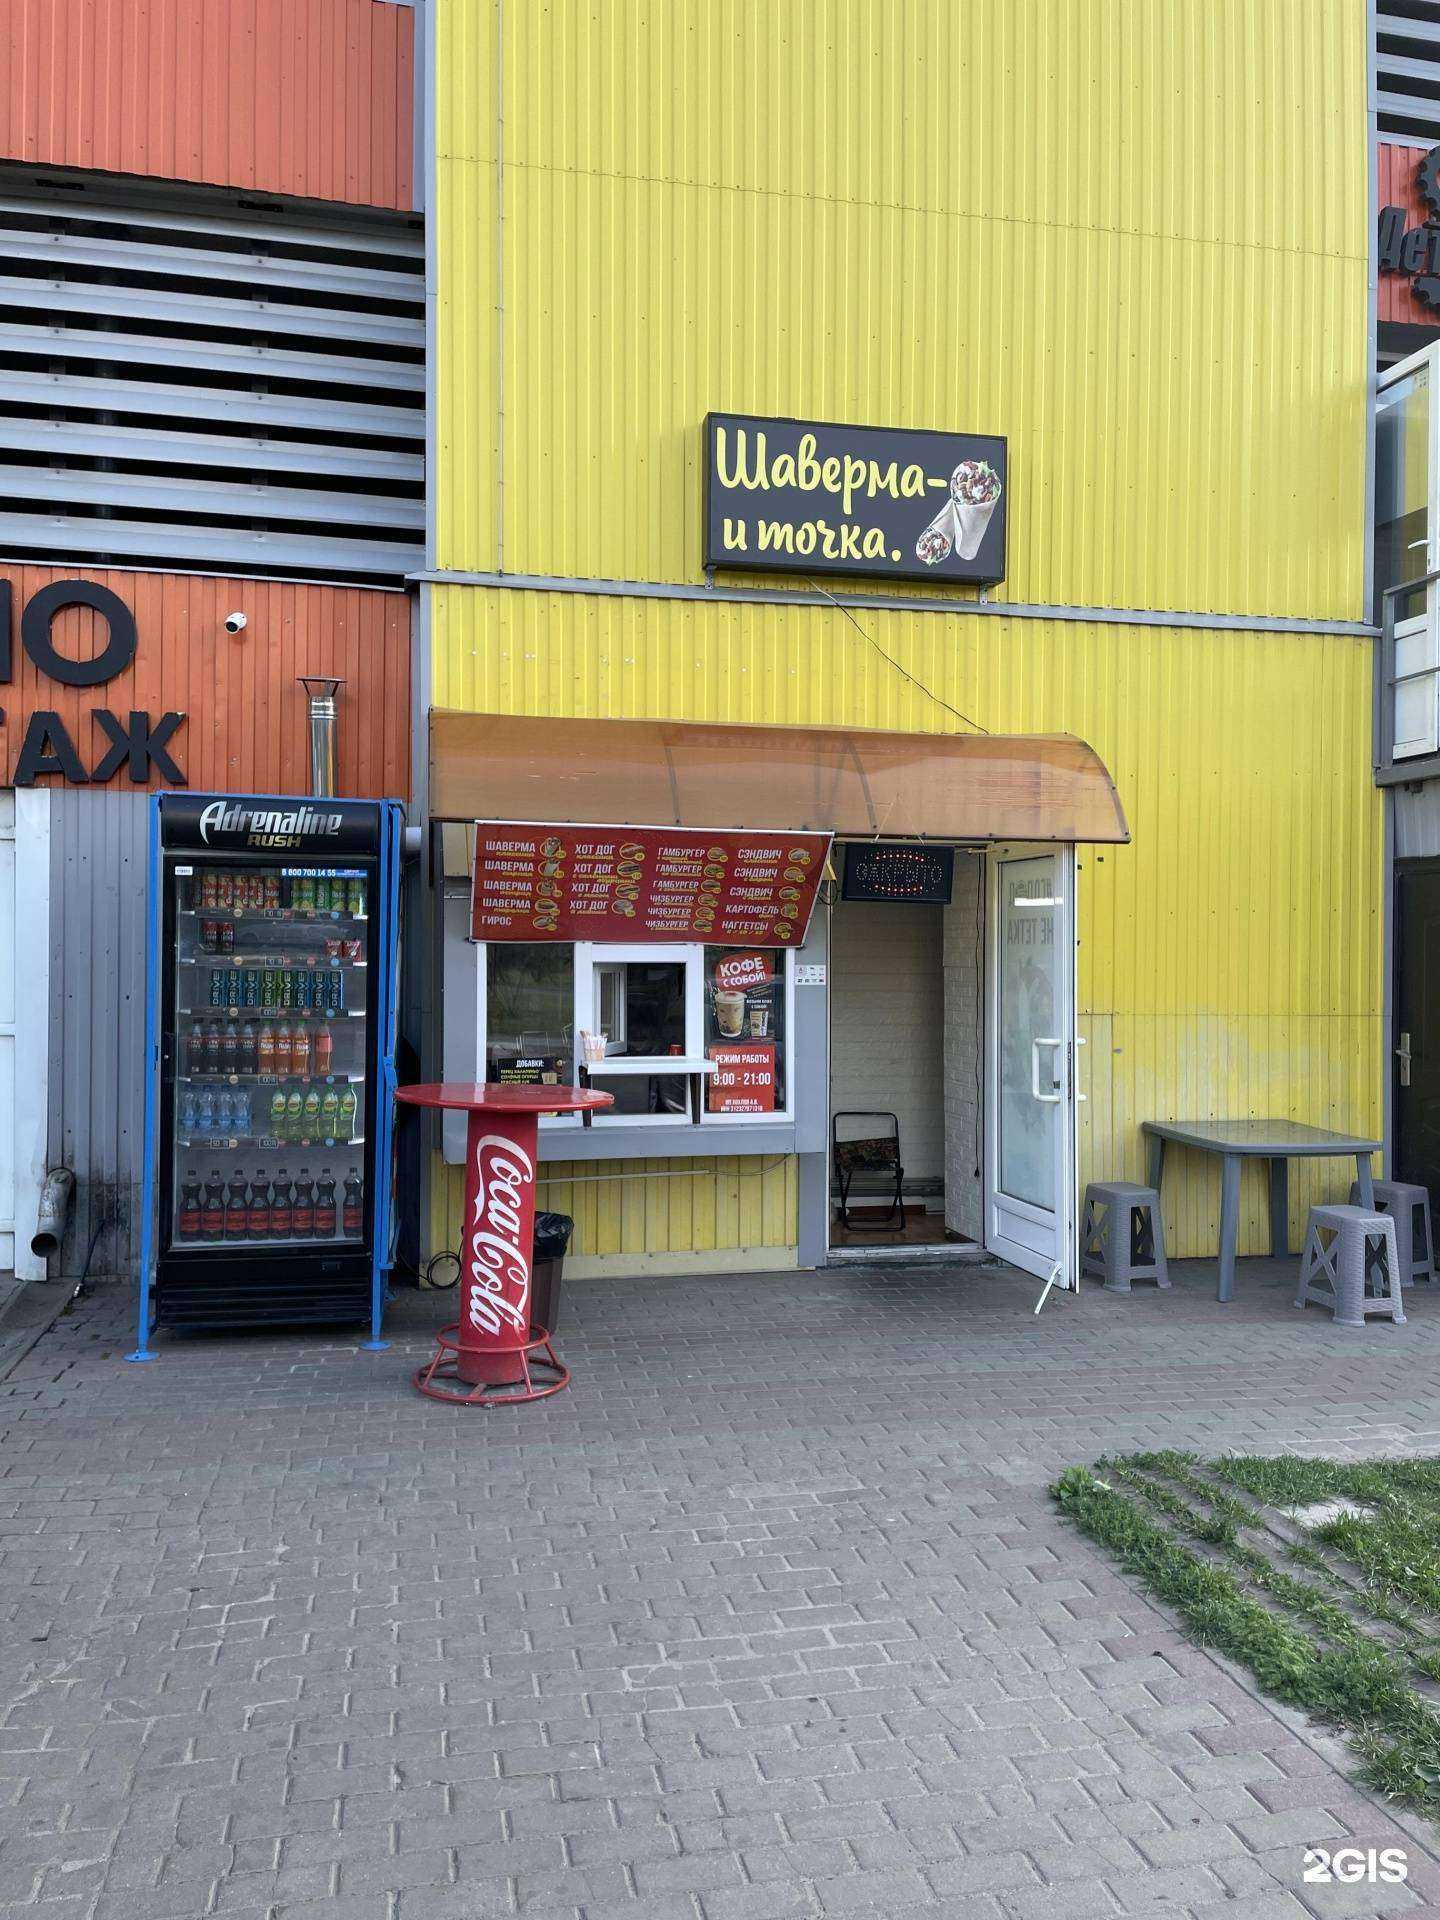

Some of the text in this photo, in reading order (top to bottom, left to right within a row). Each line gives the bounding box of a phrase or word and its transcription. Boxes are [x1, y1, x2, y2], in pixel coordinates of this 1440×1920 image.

[723, 518, 902, 562] и точка.
[199, 800, 342, 845] Adrenaline
[247, 834, 302, 848] RUSH
[485, 840, 536, 852] ШАВЕРМА
[575, 844, 615, 856] ХОТ ДОГ
[658, 847, 705, 858] ГАМБУРГЕР
[738, 849, 782, 860] СЭНДВИЧ
[484, 860, 534, 872] ШАВЕРМА
[573, 863, 614, 875] ХОТ ДОГ
[656, 864, 702, 874] ГАМБУРГЕР
[288, 868, 302, 876] 800
[303, 868, 316, 876] 700
[734, 868, 778, 878] СЭНДВИЧ
[483, 880, 533, 892] ШАВЕРМА
[571, 882, 611, 894] ХОТ ДОГ
[653, 880, 699, 890] ГАМБУРГЕР
[730, 887, 773, 898] СЭНДВИЧ
[482, 898, 531, 910] ШАВЕРМА
[650, 894, 695, 904] ЧИЗБУРГЕР
[569, 900, 608, 911] ХОТ ДОГ
[726, 904, 779, 915] КАРТОФЕЛЬ
[647, 907, 691, 916] ЧИЗБУРГЕР
[481, 915, 512, 926] ГИРОС
[645, 920, 689, 929] ЧИЗБУРГЕР
[722, 921, 768, 931] НАГГЕТСЫ
[719, 956, 765, 978] КОФЕ
[723, 970, 767, 988] С СОБОЙ!
[715, 1054, 769, 1065] РЕЖИМ РАБОТЫ
[713, 1072, 735, 1086] 9:00
[743, 1072, 771, 1086] 21:00
[469, 1134, 533, 1344] Coca-Cola
